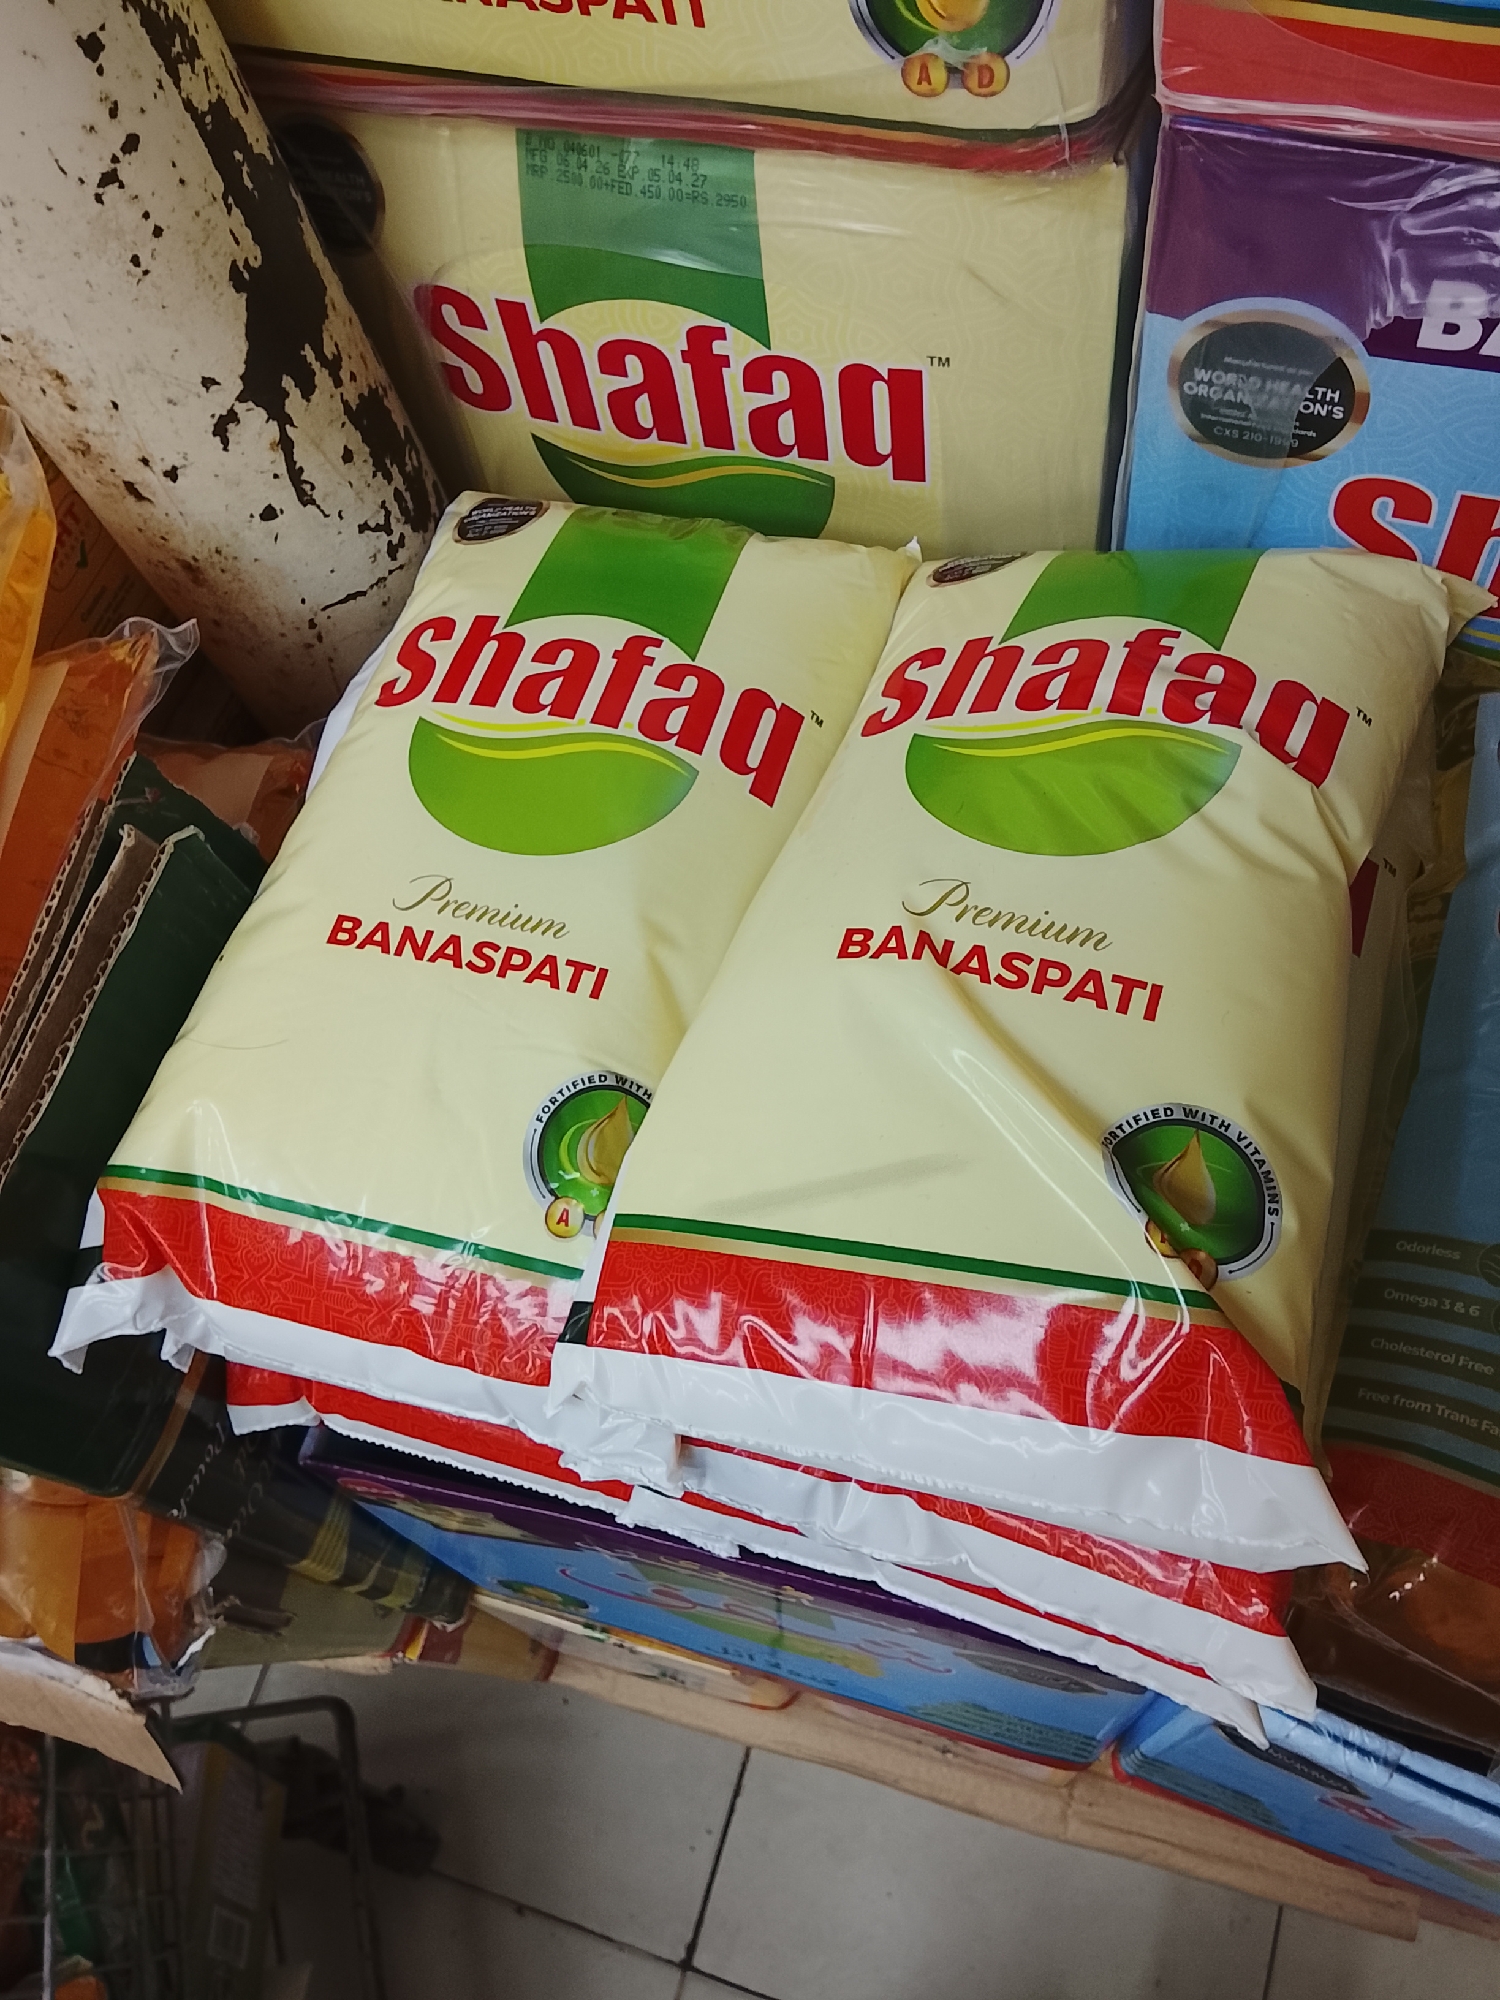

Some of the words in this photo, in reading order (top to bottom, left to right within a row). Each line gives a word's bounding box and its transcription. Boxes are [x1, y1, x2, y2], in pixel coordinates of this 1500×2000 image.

[917, 63, 932, 86] A
[978, 64, 995, 88] D
[431, 284, 927, 484] Shafaq
[374, 614, 806, 809] Shafaq
[860, 628, 1350, 790] Shafaq
[392, 874, 571, 940] Premium
[901, 879, 1113, 952] Premium
[326, 914, 609, 1000] BANASPATI
[836, 925, 1164, 1023] BANASPATI
[535, 1073, 608, 1124] FORTIFIED
[615, 1074, 653, 1101] WITH
[1181, 1106, 1232, 1133] WITH
[1236, 1130, 1280, 1217] VITAMINS
[556, 1208, 570, 1227] A
[1396, 1240, 1461, 1261] Odorless
[1383, 1288, 1438, 1308] Omega
[1441, 1297, 1451, 1310] 3
[1454, 1302, 1465, 1314] &
[1469, 1305, 1480, 1317] 6
[1370, 1337, 1455, 1364] Cholesterol
[1458, 1355, 1495, 1376] Free
[1357, 1387, 1391, 1405] Free
[1393, 1393, 1432, 1414] from
[1435, 1402, 1478, 1428] Trans
[1481, 1419, 1500, 1438] Fa
